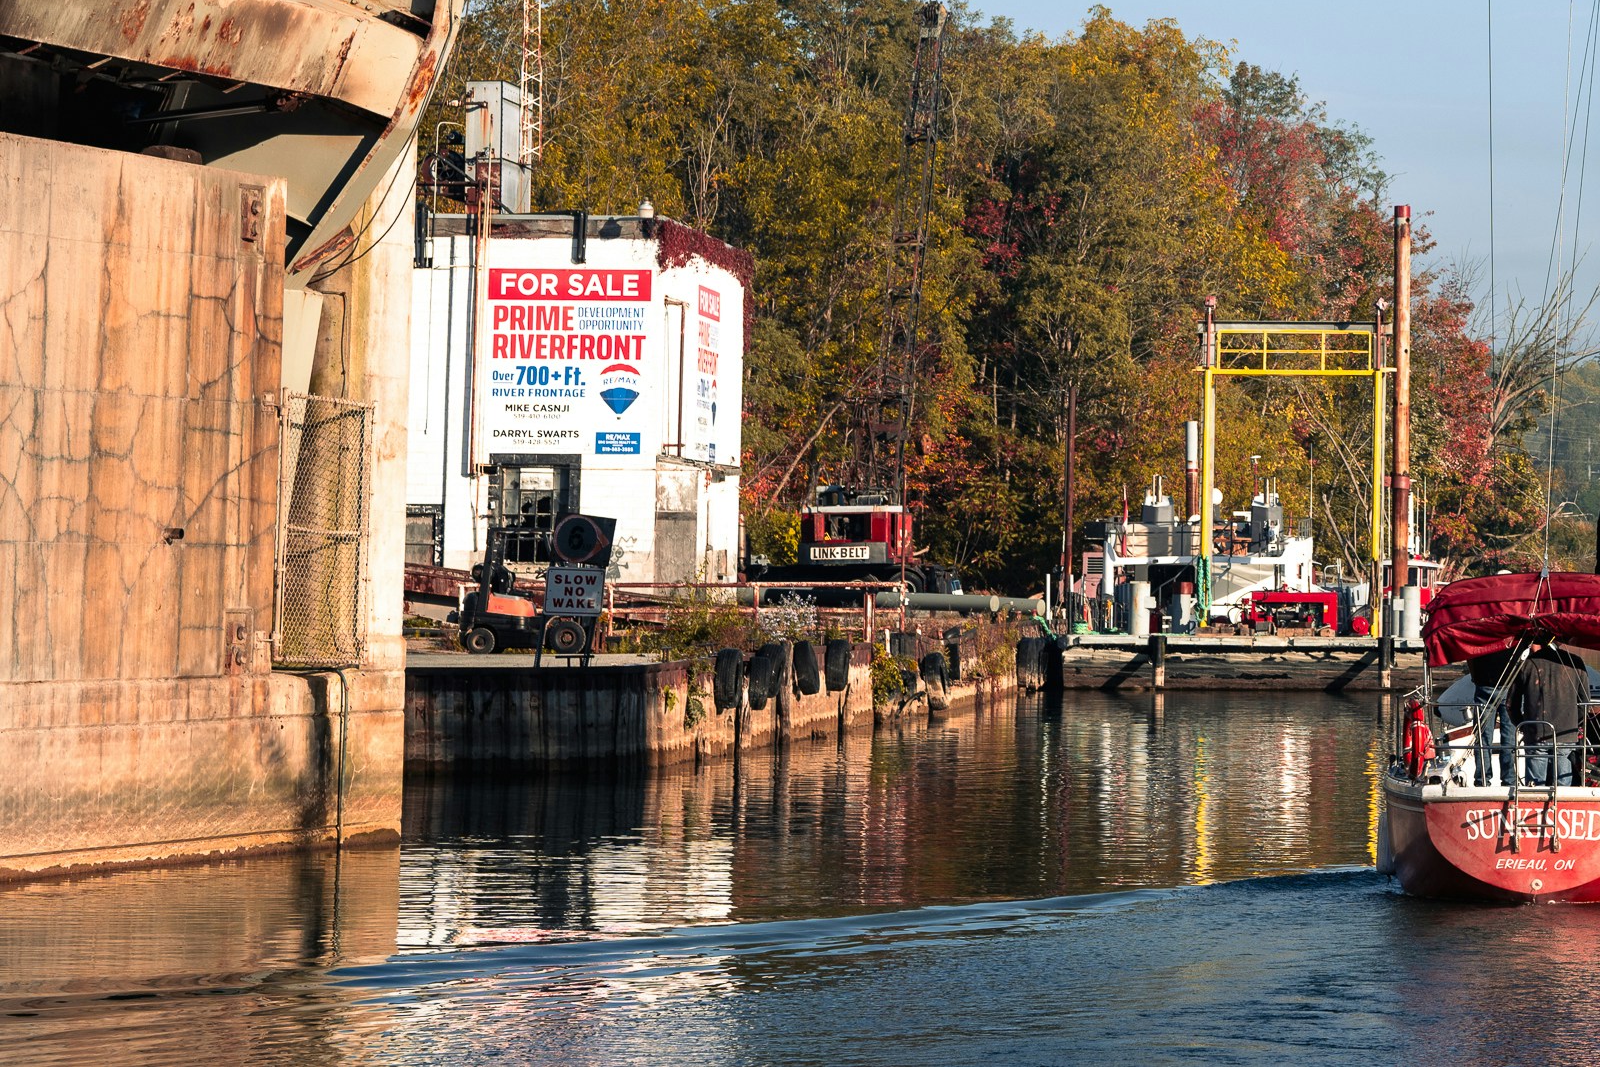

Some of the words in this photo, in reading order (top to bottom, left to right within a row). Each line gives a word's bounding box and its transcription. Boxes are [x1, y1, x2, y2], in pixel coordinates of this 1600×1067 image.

[500, 272, 559, 296] FOR
[567, 273, 640, 297] SALE
[493, 305, 575, 331] PRIME
[578, 306, 646, 319] DEVELOPMENT
[579, 319, 644, 331] OPPORTUNITY
[492, 333, 647, 360] RIVERFRONT
[492, 370, 515, 381] Over
[564, 366, 586, 386] Ft.
[603, 376, 637, 386] RE/MAX
[492, 388, 525, 397] RIVER
[528, 388, 586, 398] FRONTAGE
[505, 404, 530, 412] MIKE
[533, 404, 570, 413] CASNJI
[493, 429, 534, 438] DARRYL
[537, 430, 580, 439] SWARTS
[605, 433, 631, 441] RE/MAX
[813, 547, 867, 559] LINK-BELT
[554, 574, 597, 585] SLOW
[564, 586, 585, 596] NO
[552, 598, 596, 609] WAKE
[1495, 858, 1548, 871] ERIEAU,
[1553, 859, 1576, 871] ON
